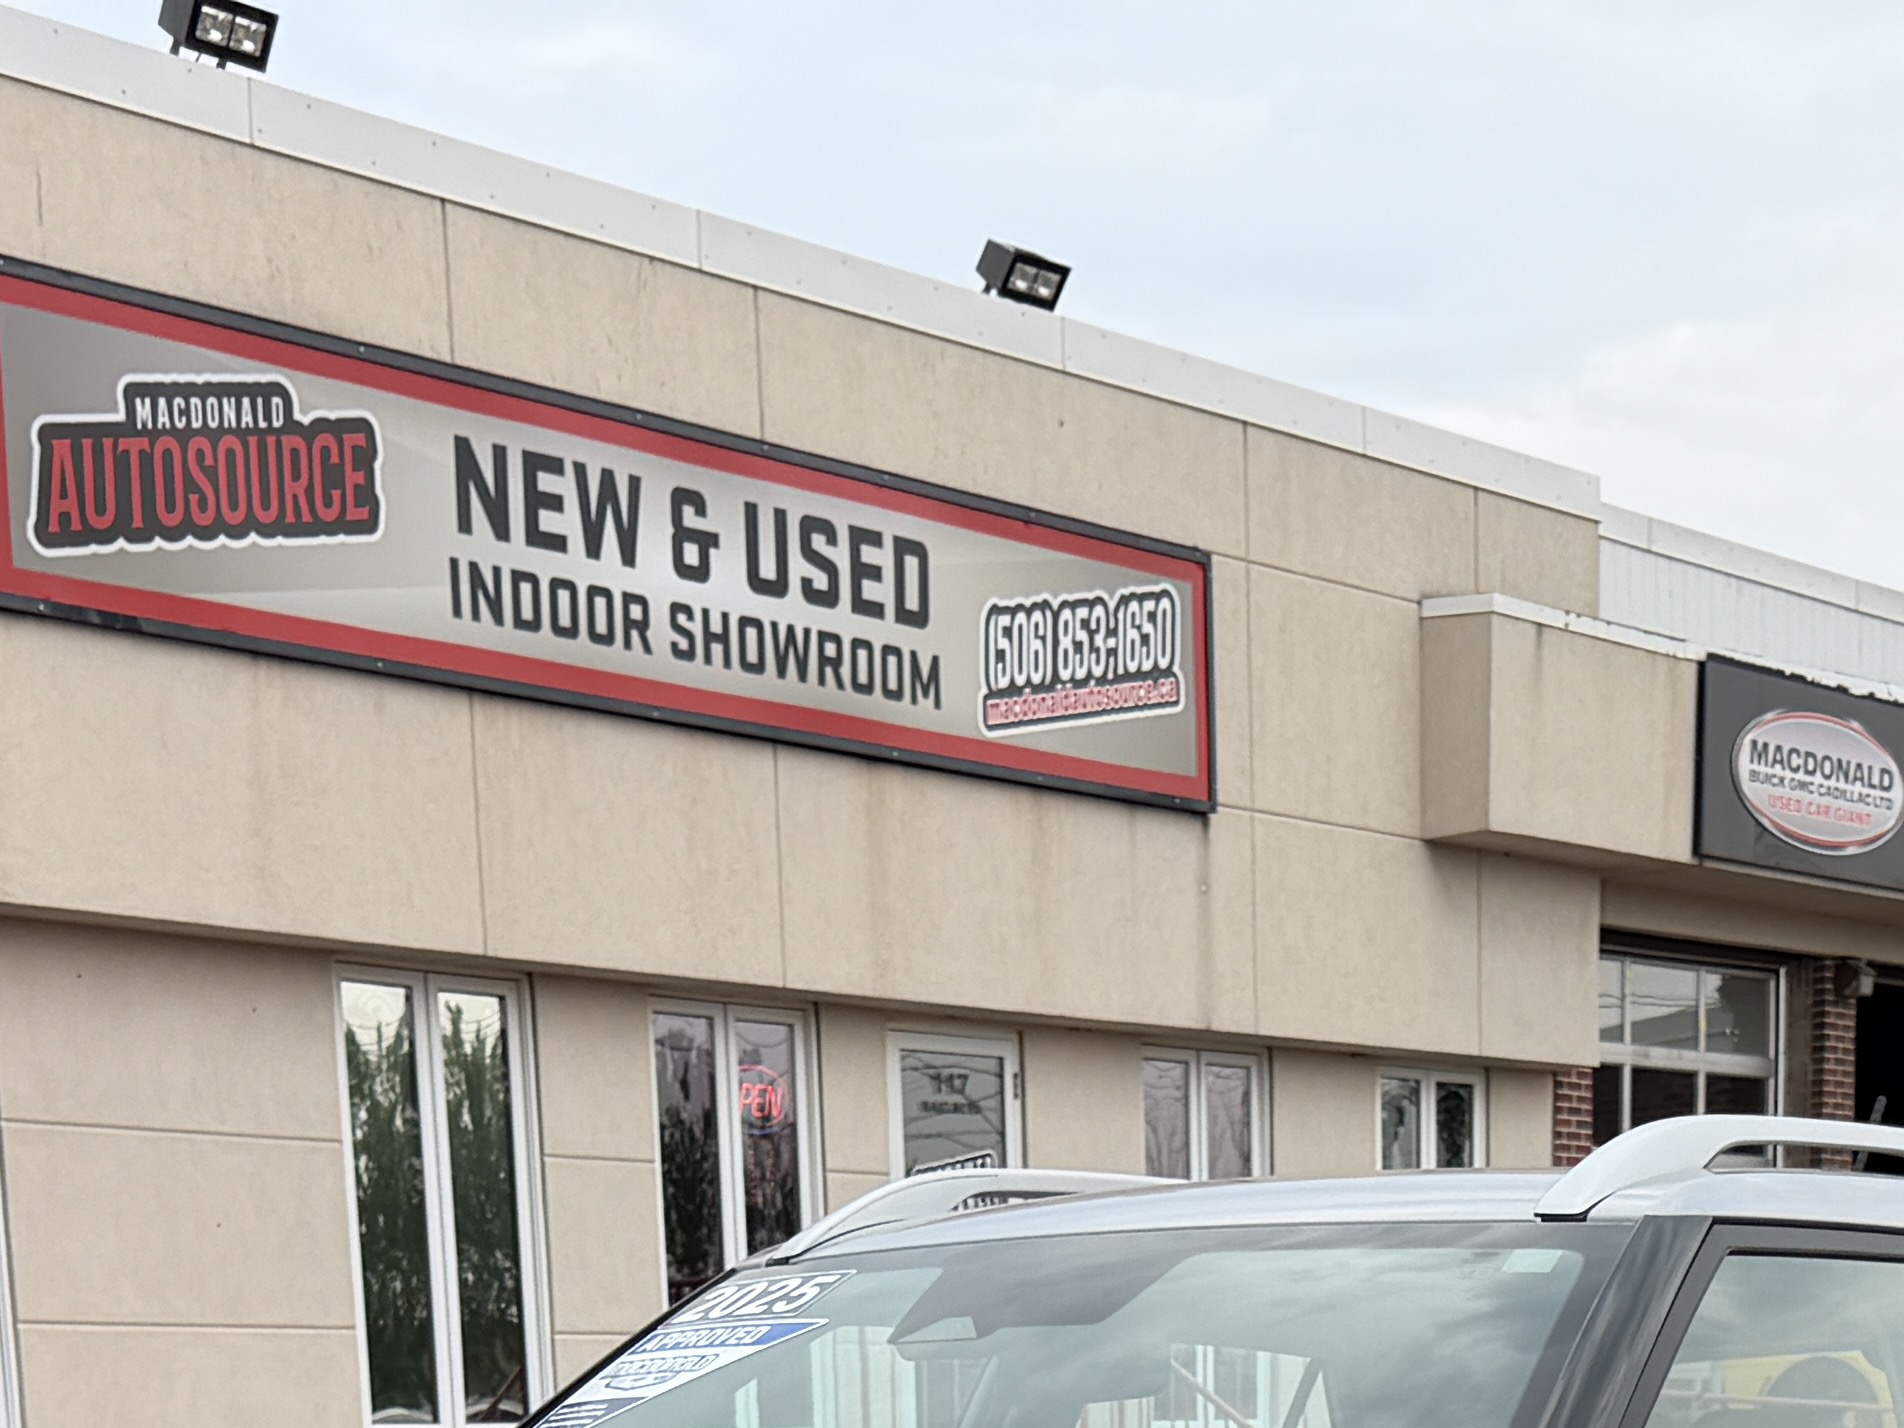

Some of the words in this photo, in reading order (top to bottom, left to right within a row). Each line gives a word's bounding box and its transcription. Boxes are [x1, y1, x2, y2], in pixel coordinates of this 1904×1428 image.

[135, 397, 285, 430] MACDONALD
[48, 433, 370, 533] AUTOSOURCE
[453, 434, 642, 569] NEW
[670, 486, 720, 584] &
[743, 501, 930, 630] USED
[449, 557, 653, 656] INDOOR
[669, 601, 942, 711] SHOWROOM
[988, 607, 1053, 692] (506)
[1058, 597, 1173, 681] 853-1650
[1749, 739, 1894, 792] MACDONALD
[1749, 769, 1786, 788] BUICK
[1788, 777, 1815, 795] GMC
[1816, 783, 1871, 808] CADILLAC
[1768, 794, 1803, 814] USED
[1805, 801, 1832, 819] CAR
[1835, 807, 1872, 828] GIANT
[739, 1083, 784, 1118] PEN
[671, 1275, 842, 1323] 2025
[637, 1326, 772, 1352] APPROVED
